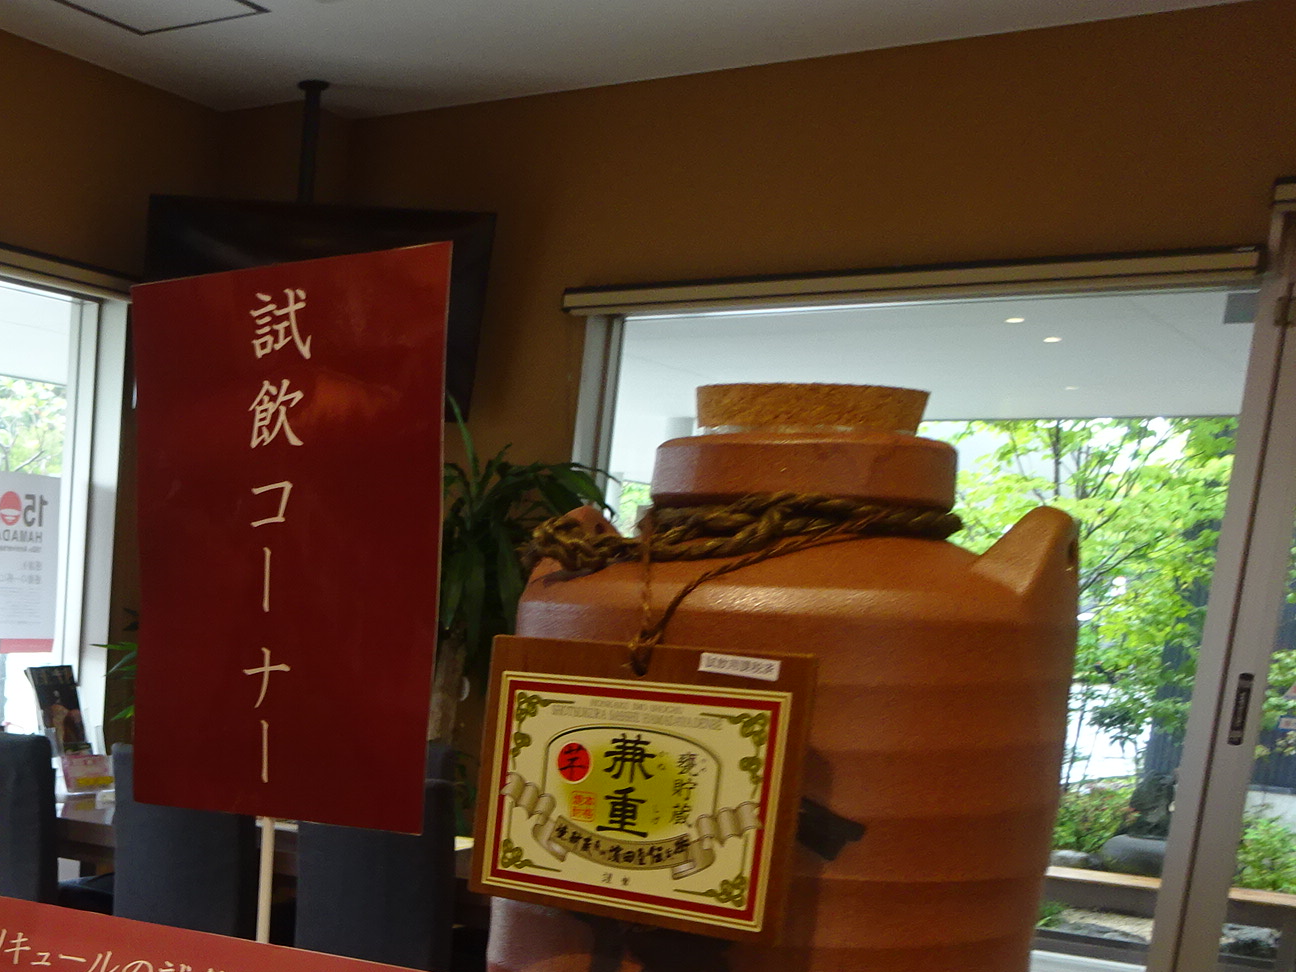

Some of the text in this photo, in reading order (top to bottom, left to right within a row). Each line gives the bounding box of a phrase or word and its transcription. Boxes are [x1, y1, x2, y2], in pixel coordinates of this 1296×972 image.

[242, 288, 312, 784] 試飲コーナー
[596, 732, 657, 838] 兼重
